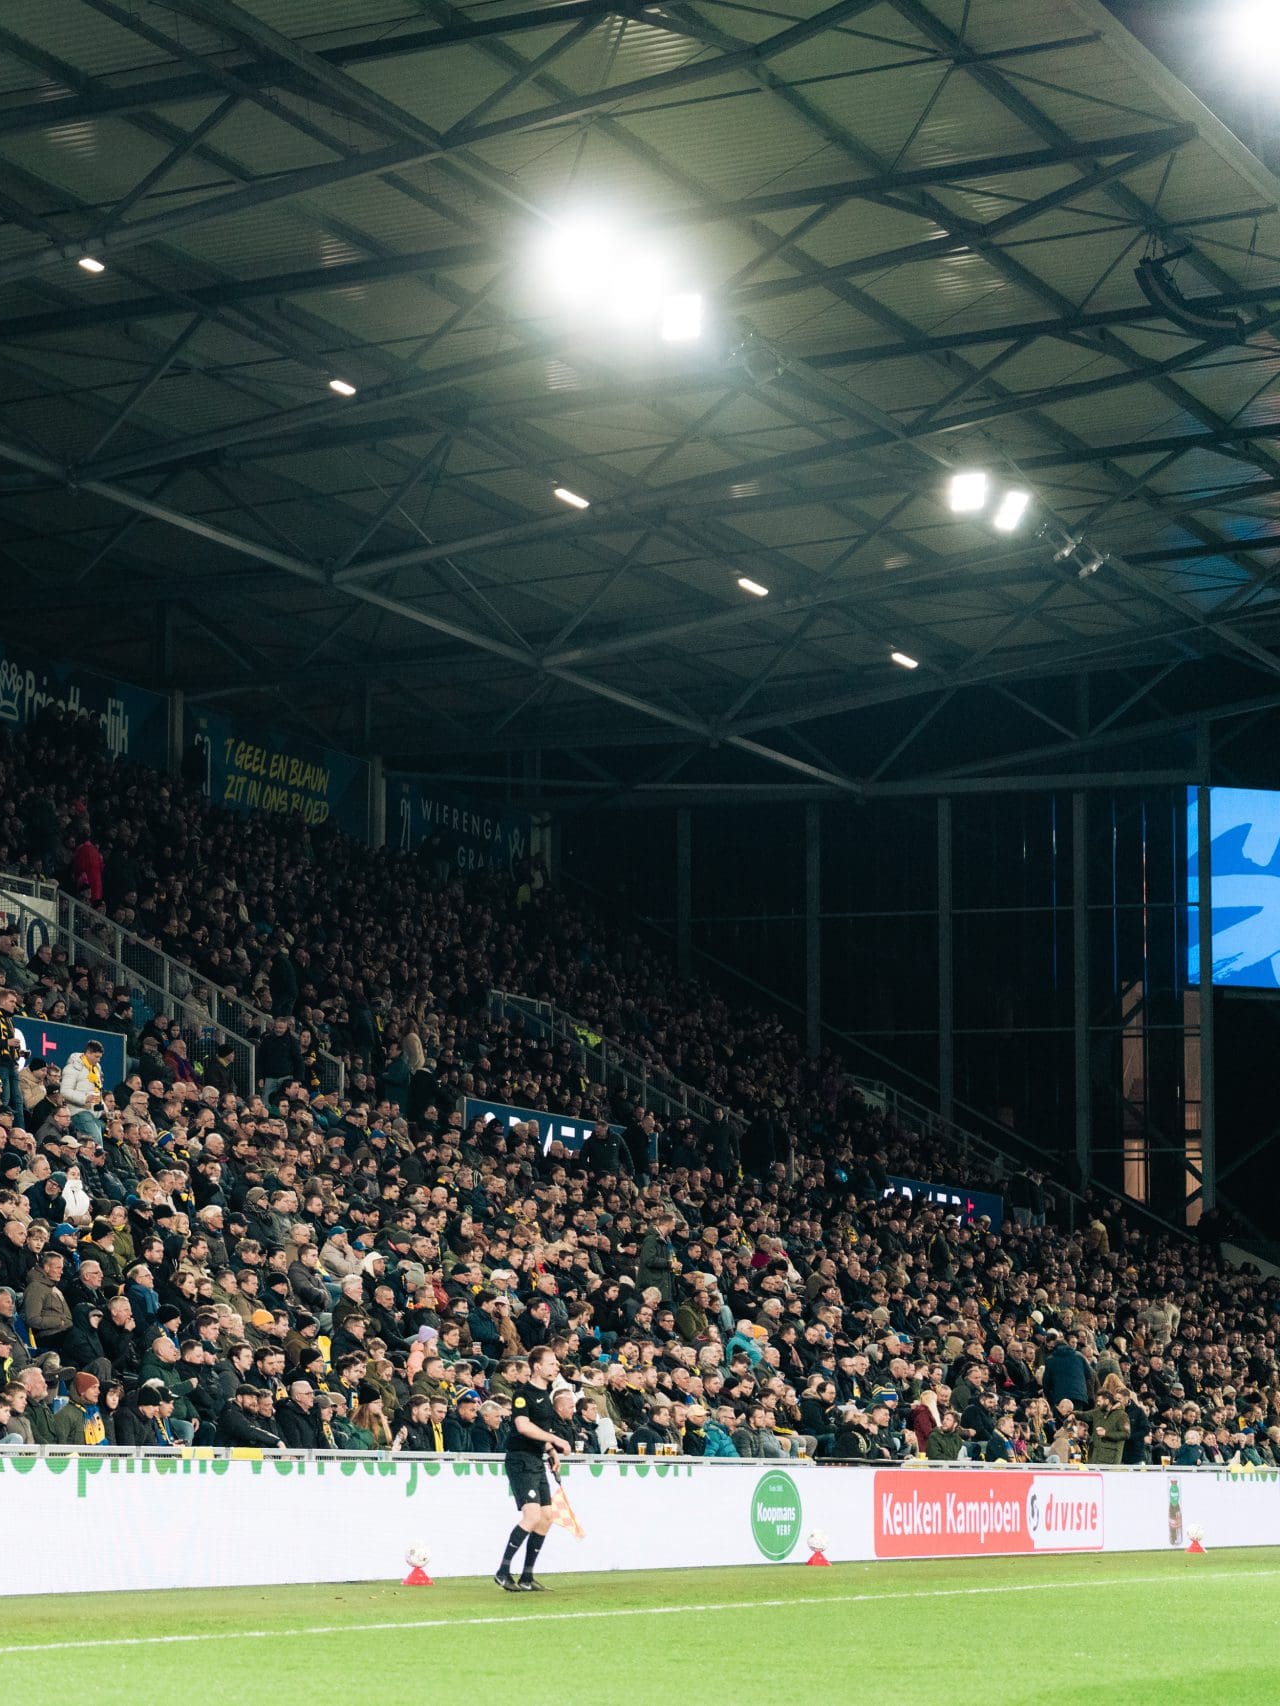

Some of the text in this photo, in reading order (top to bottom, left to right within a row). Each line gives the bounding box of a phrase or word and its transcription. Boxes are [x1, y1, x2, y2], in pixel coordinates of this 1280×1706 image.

[234, 740, 267, 776] GEEL
[269, 753, 289, 783] EN
[287, 757, 331, 797] BLAUW
[224, 774, 248, 802] ZIT
[246, 779, 263, 809] IN
[261, 784, 289, 814] ONS
[420, 797, 503, 844] WIERENGA
[756, 1501, 796, 1525] Koopmans
[775, 1524, 791, 1536] VERF
[881, 1489, 942, 1536] Keuken
[945, 1488, 1021, 1544] Kampioen
